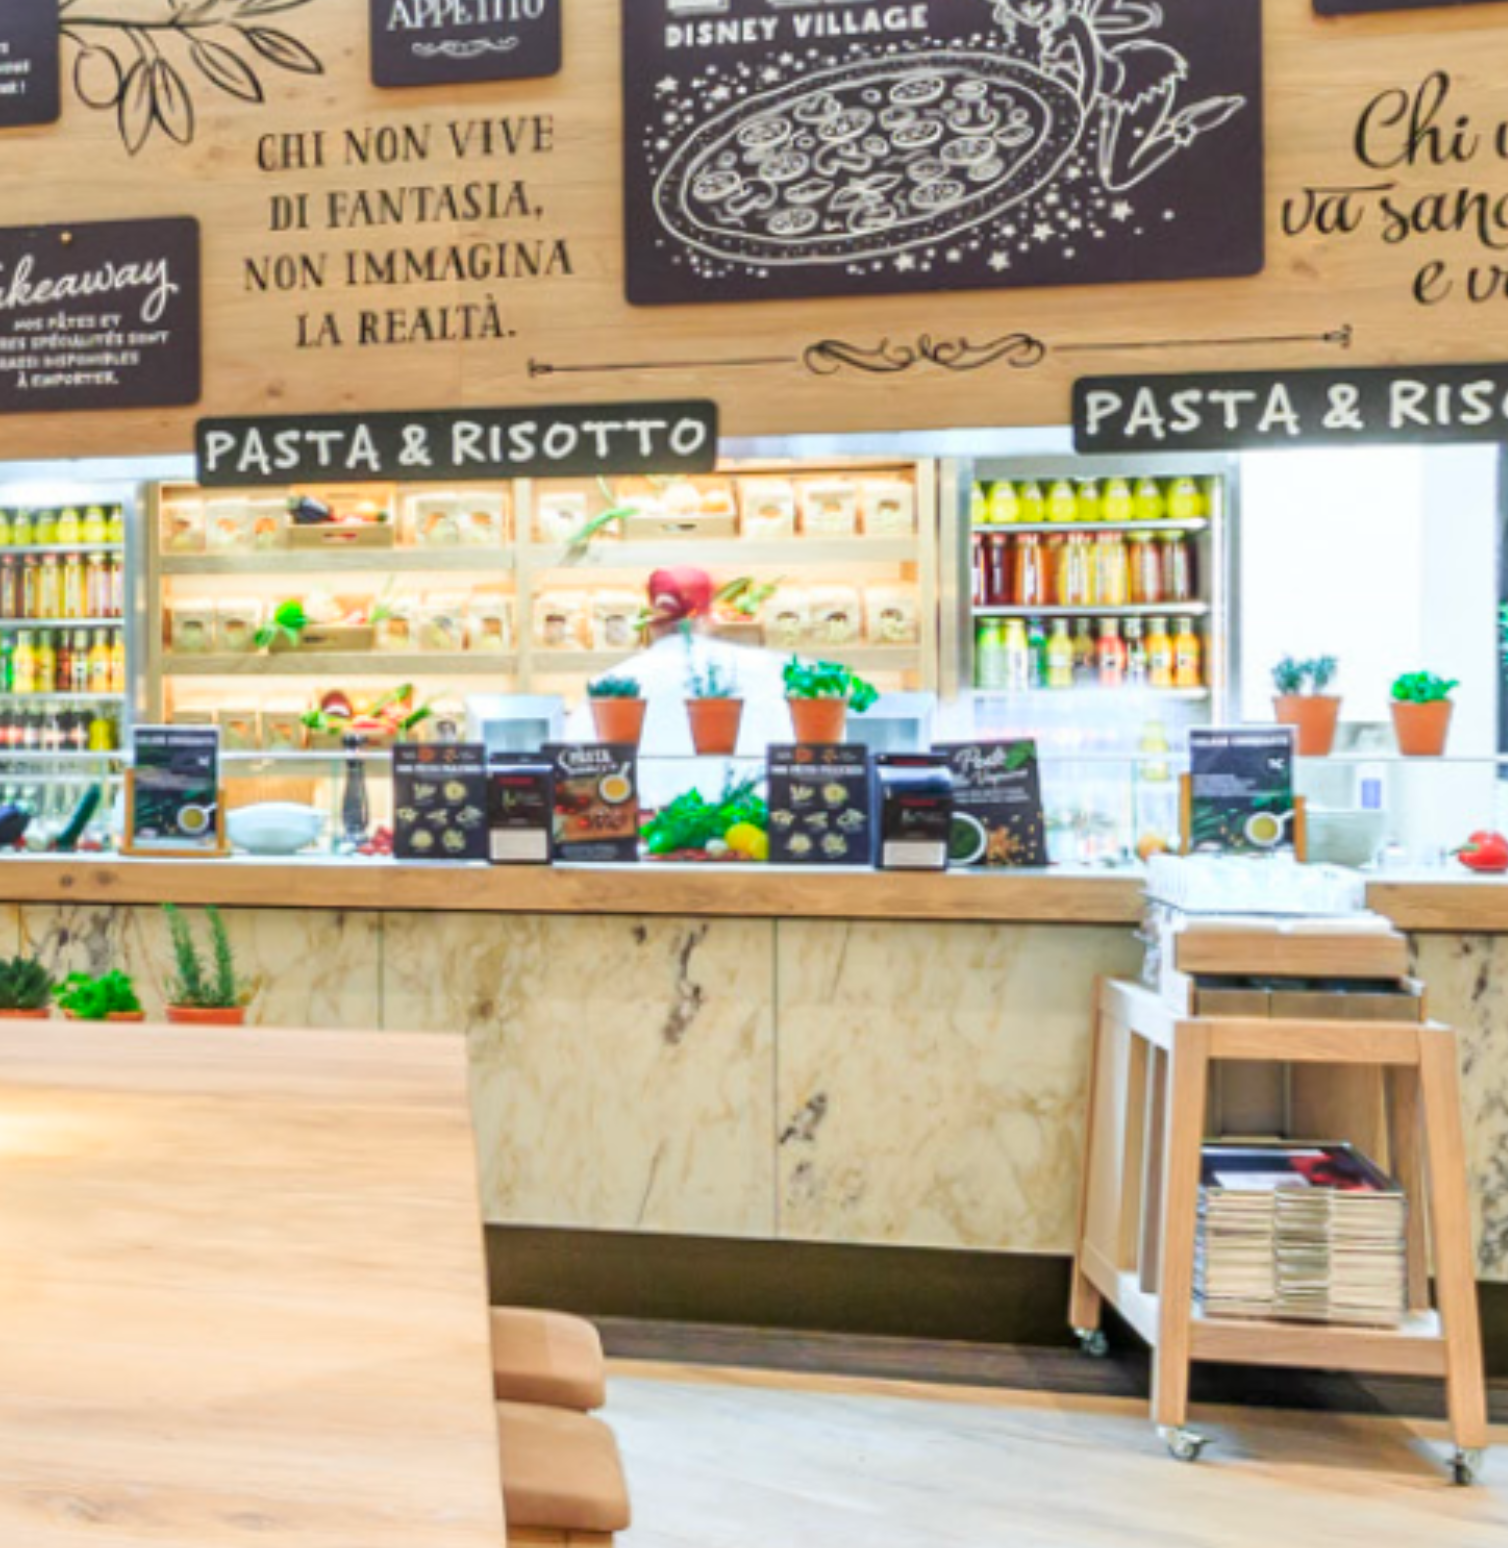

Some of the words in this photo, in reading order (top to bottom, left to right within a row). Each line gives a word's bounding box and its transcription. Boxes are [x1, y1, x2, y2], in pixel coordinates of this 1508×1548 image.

[665, 16, 779, 47] DISNEY
[793, 5, 929, 37] VILLAGE
[257, 131, 325, 171] CHI
[344, 123, 432, 165] NON
[448, 115, 554, 158] VIVE
[1353, 70, 1481, 170] Chi
[269, 193, 309, 231] DI
[325, 180, 544, 228] FANTASIA,
[1281, 182, 1397, 237] va
[244, 253, 327, 291] NON
[345, 239, 575, 286] IMMAGINA
[1412, 260, 1454, 306] e
[1467, 264, 1508, 304] v
[296, 313, 342, 348] LA
[358, 293, 517, 345] REALTÀ.
[1086, 382, 1300, 440] PASTA
[1322, 383, 1364, 430] &
[1389, 379, 1508, 429] RIS
[205, 423, 381, 476] PASTA
[398, 424, 432, 466] &
[451, 417, 706, 466] RISOTTO
